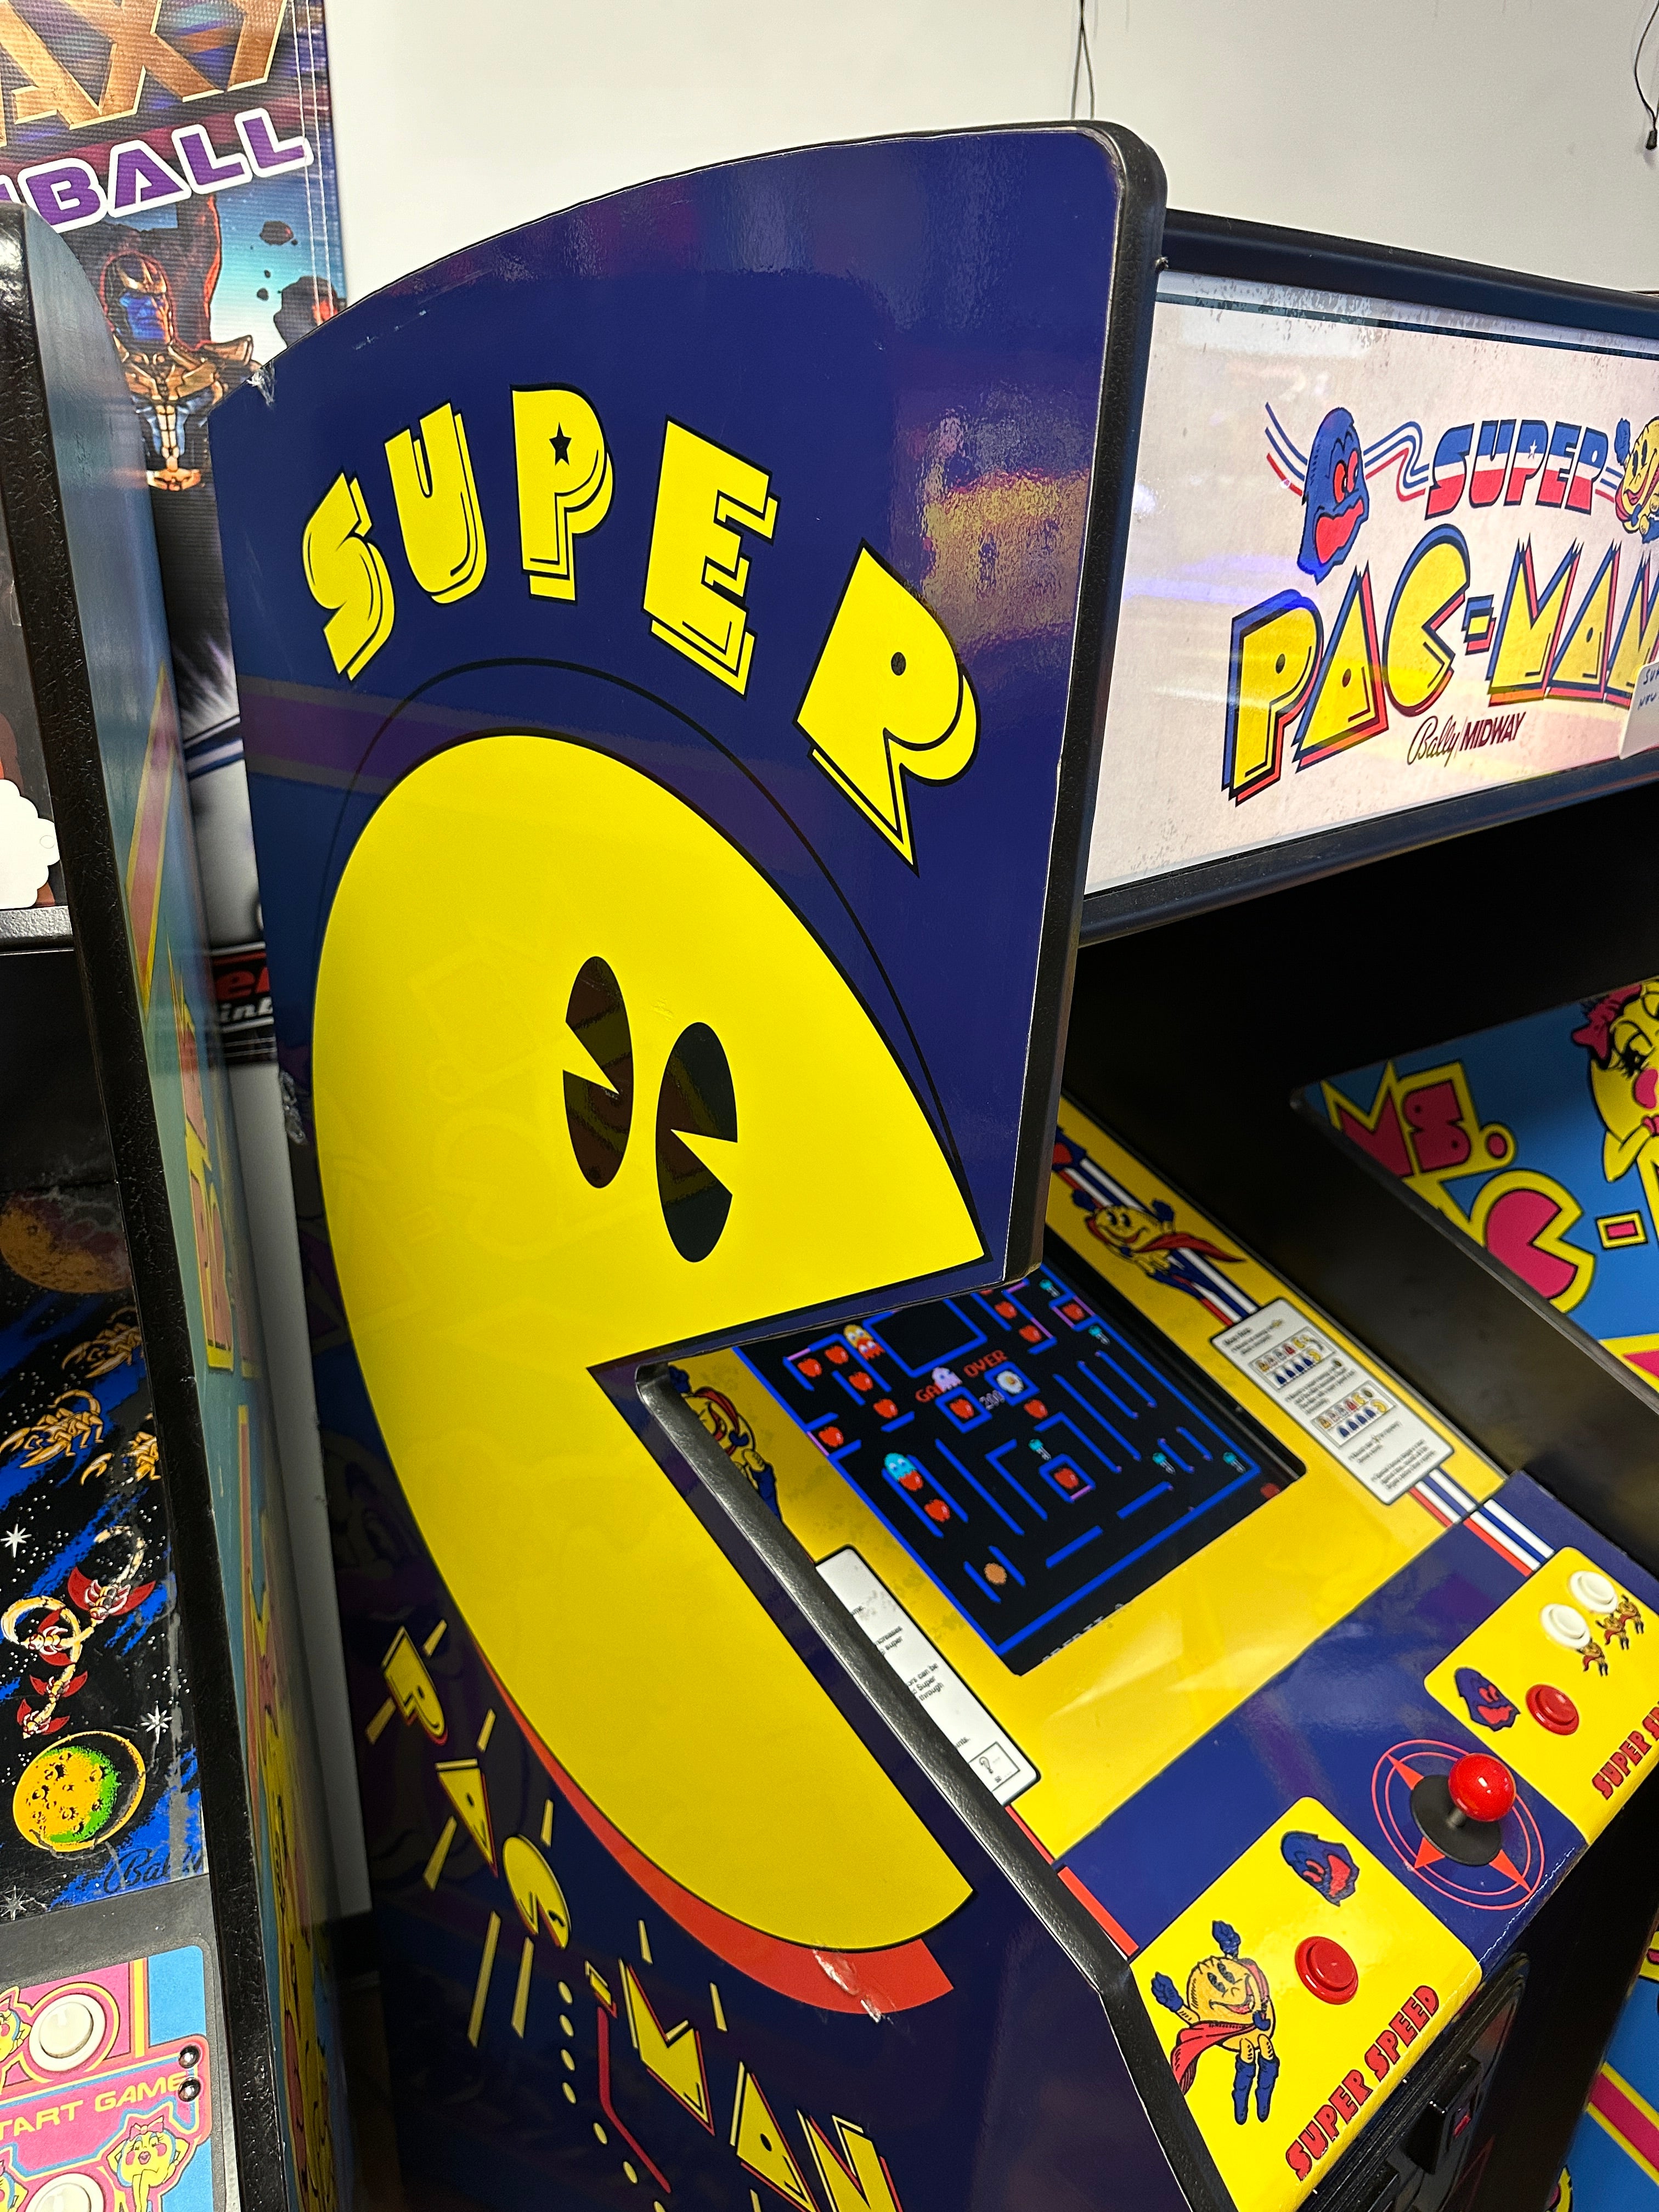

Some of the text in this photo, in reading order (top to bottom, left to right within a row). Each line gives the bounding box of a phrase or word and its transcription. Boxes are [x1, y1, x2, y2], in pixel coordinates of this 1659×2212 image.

[0, 108, 313, 233] BALL
[1425, 419, 1609, 521] SUPER
[301, 383, 980, 876] SUPER
[1407, 711, 1526, 768] Bally MIDWAY
[963, 1350, 1008, 1378] OVER
[1592, 1730, 1652, 1800] SUPER
[95, 2071, 188, 2113] GAME
[1285, 1985, 1440, 2183] SUPER SPEED
